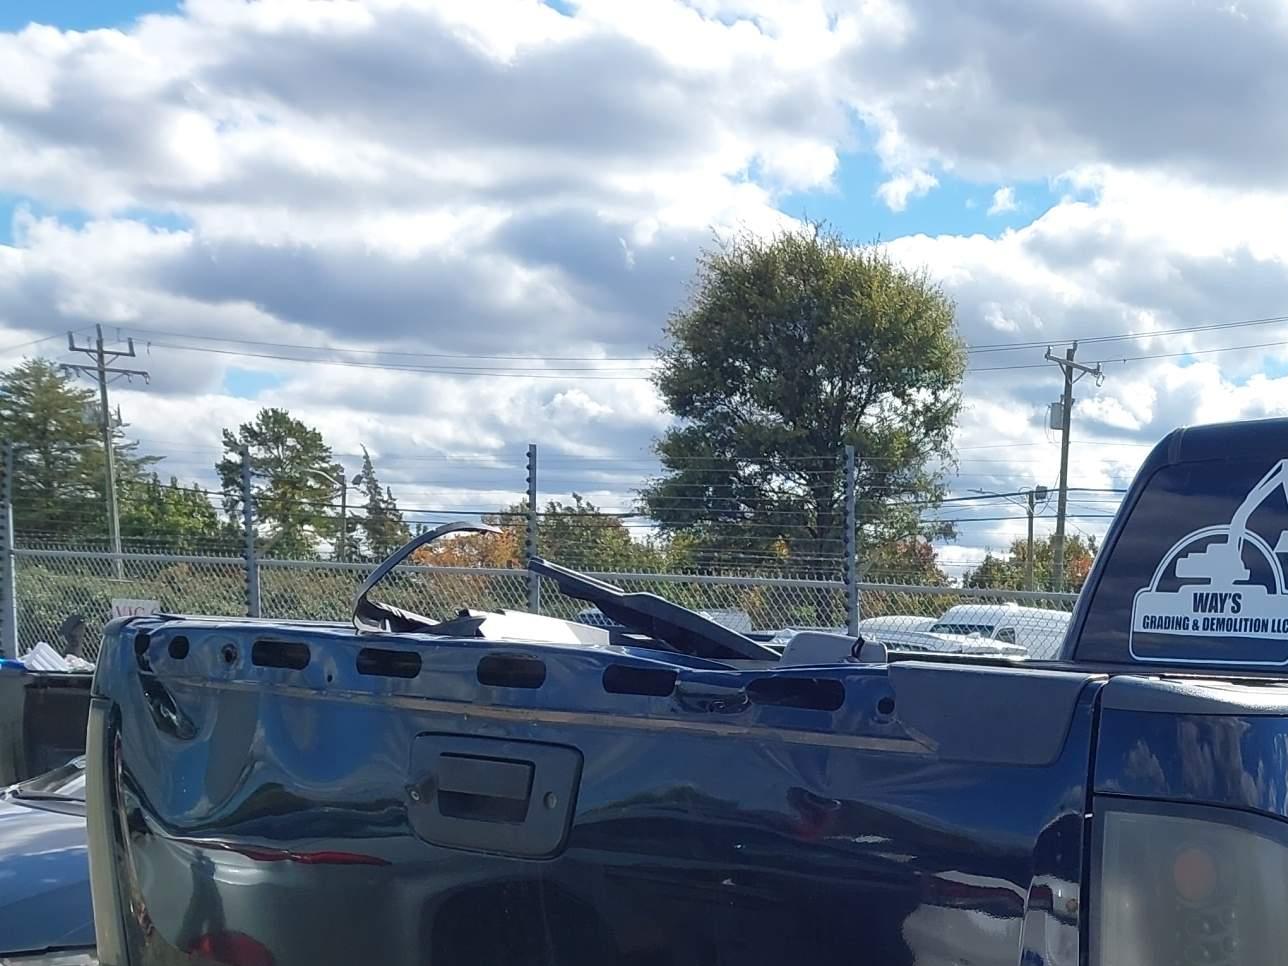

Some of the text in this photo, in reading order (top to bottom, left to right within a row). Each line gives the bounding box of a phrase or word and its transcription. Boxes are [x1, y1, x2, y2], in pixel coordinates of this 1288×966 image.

[1192, 592, 1242, 614] WAY'S
[1142, 615, 1190, 631] GRADING
[1191, 618, 1201, 631] &
[1202, 616, 1270, 633] DEMOLITION
